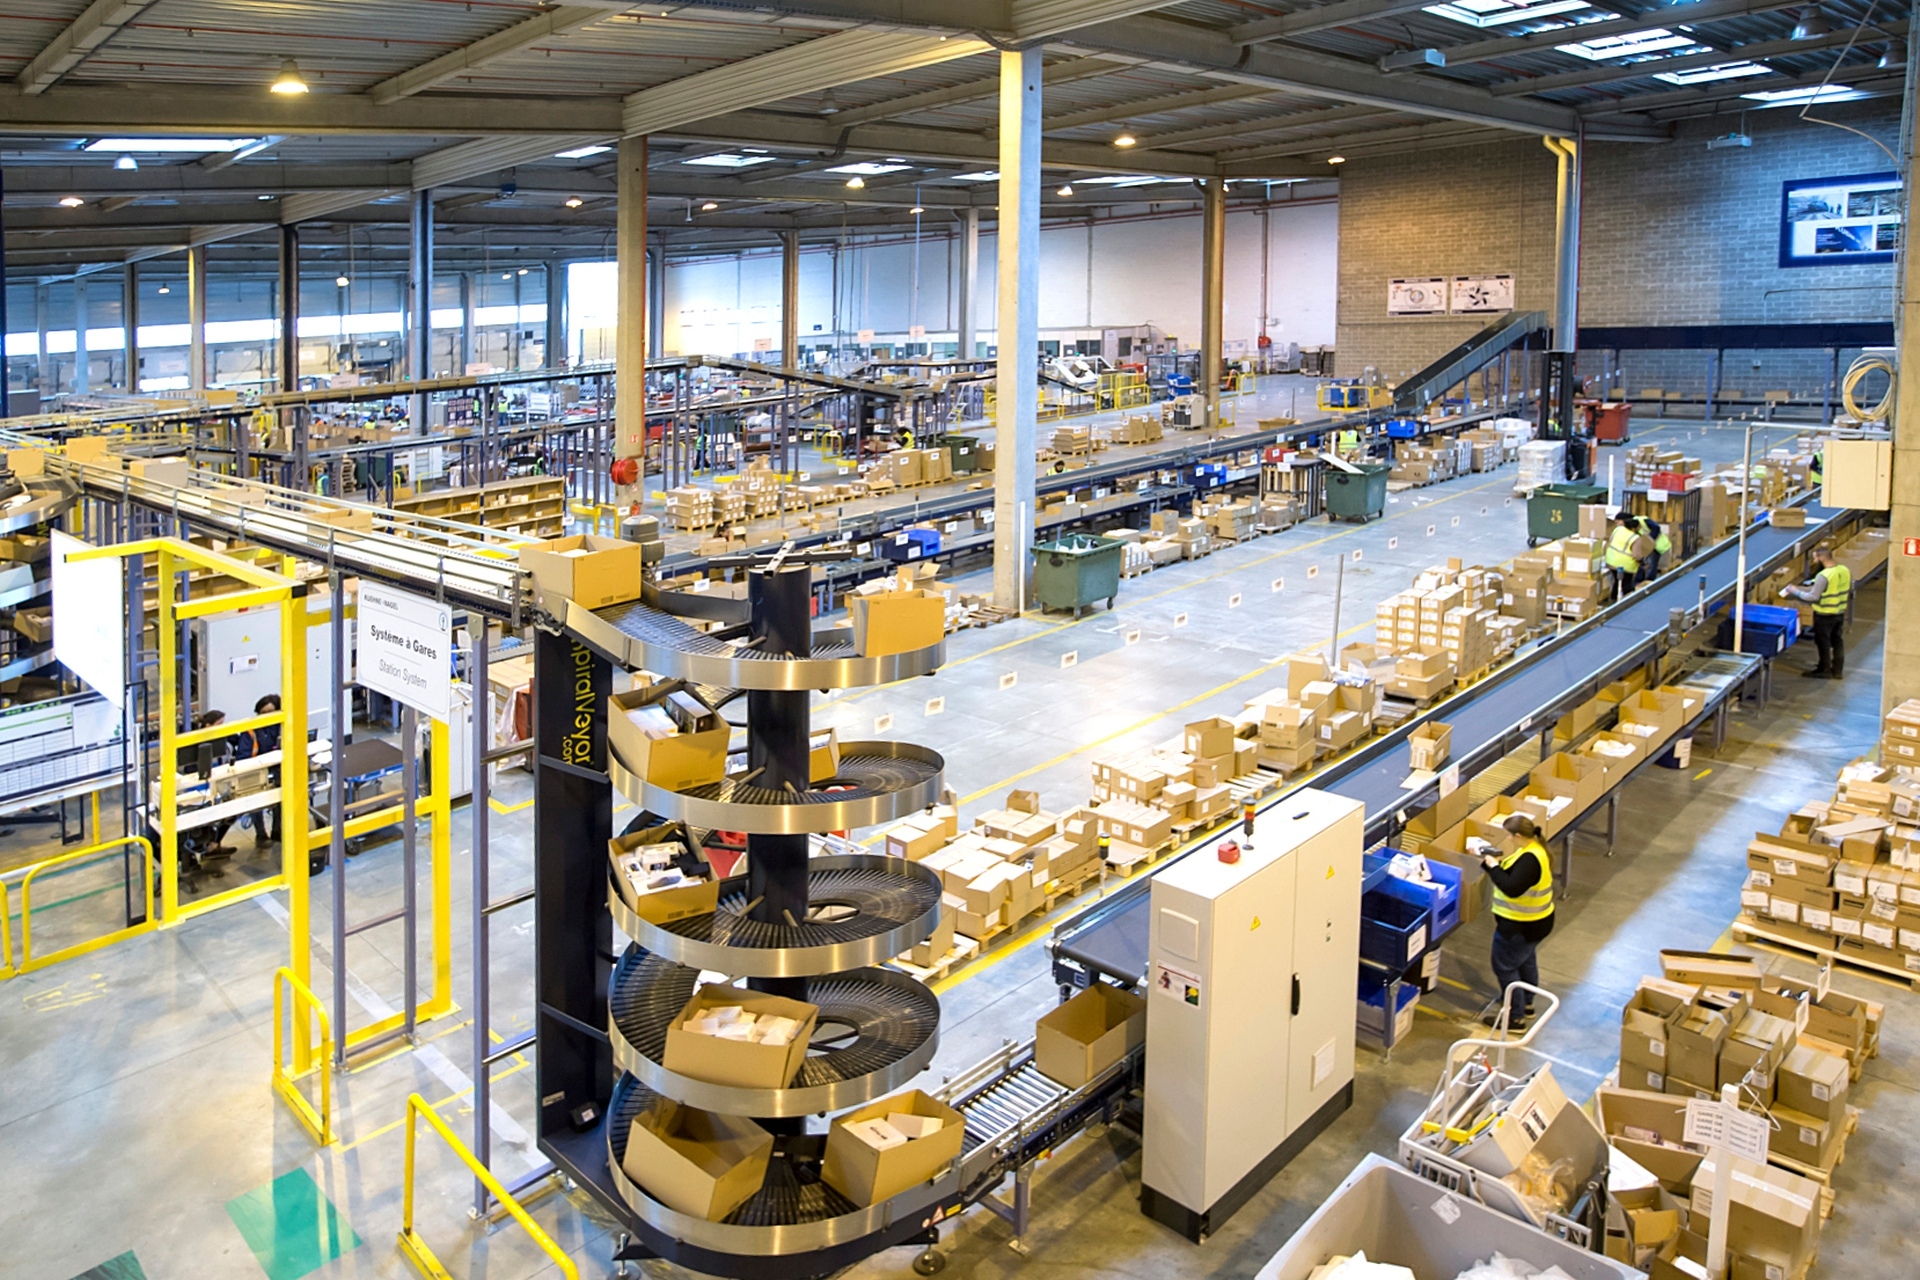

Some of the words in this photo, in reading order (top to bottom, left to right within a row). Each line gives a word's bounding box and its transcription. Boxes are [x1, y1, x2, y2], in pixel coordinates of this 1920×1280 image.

[413, 639, 437, 660] Gares
[378, 659, 401, 678] Station
[402, 668, 427, 689] System
